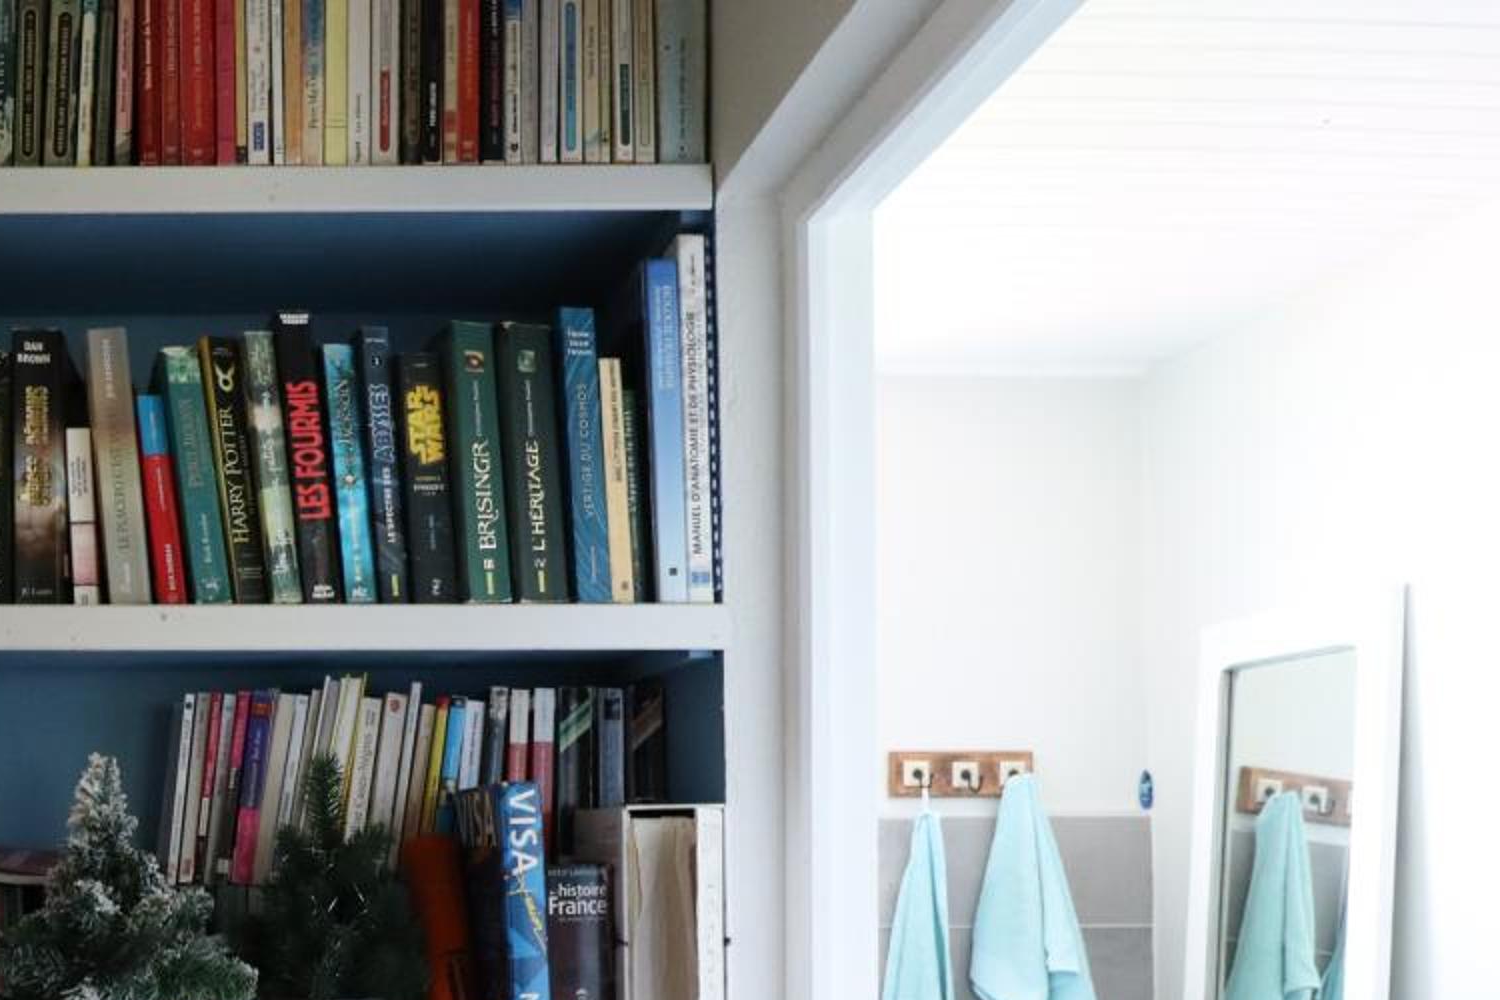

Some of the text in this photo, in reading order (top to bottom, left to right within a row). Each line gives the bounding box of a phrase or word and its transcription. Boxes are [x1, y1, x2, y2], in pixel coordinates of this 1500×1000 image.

[285, 380, 331, 520] LES FOURMIS
[368, 383, 395, 464] ABYSSES
[405, 390, 426, 456] STAR
[420, 385, 445, 464] WARS
[577, 383, 590, 438] COSMOS
[685, 312, 702, 554] MANUEL D'ANATOMIE ET DE PHYSIOLOGIE
[219, 406, 250, 543] HARRY POTTER
[471, 440, 499, 549] BRISINGR
[507, 787, 540, 880] VISA
[548, 898, 608, 915] France
